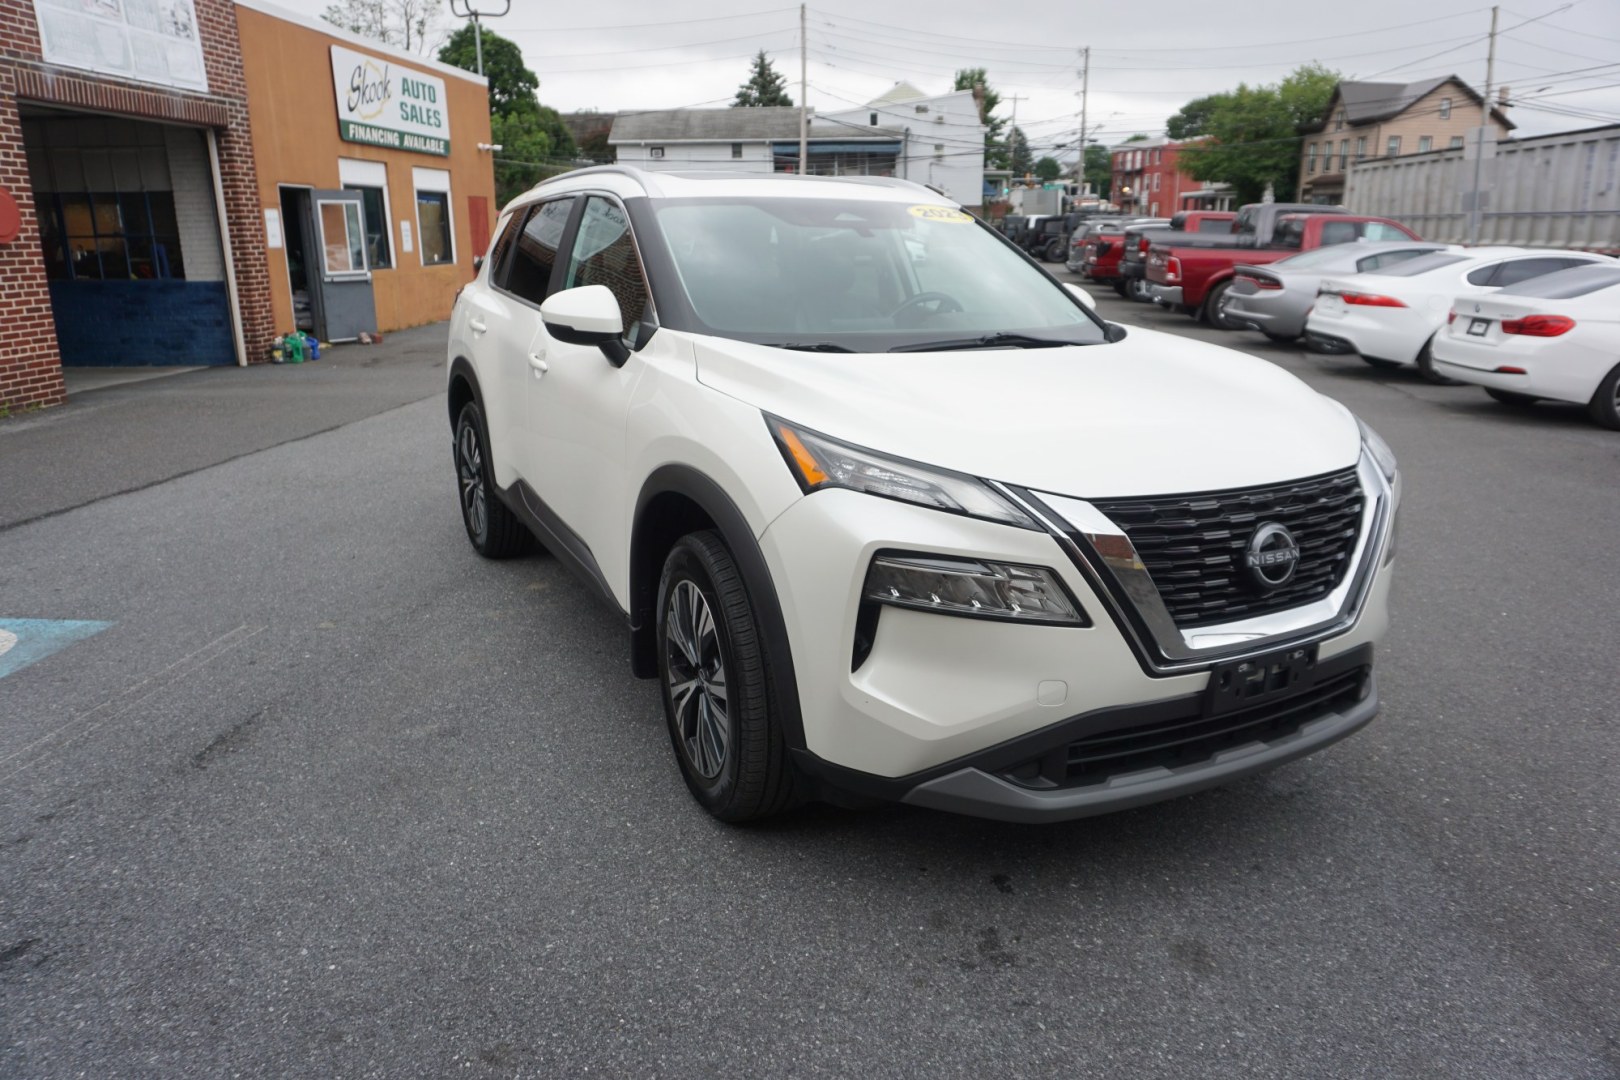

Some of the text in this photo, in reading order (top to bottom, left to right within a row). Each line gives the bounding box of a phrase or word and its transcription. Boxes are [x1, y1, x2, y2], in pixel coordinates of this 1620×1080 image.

[347, 64, 391, 112] Skook
[401, 77, 436, 103] AUTO
[400, 101, 441, 128] SALES
[348, 123, 445, 153] FINANCING AVAILABLE
[1249, 549, 1300, 565] NISSAN
